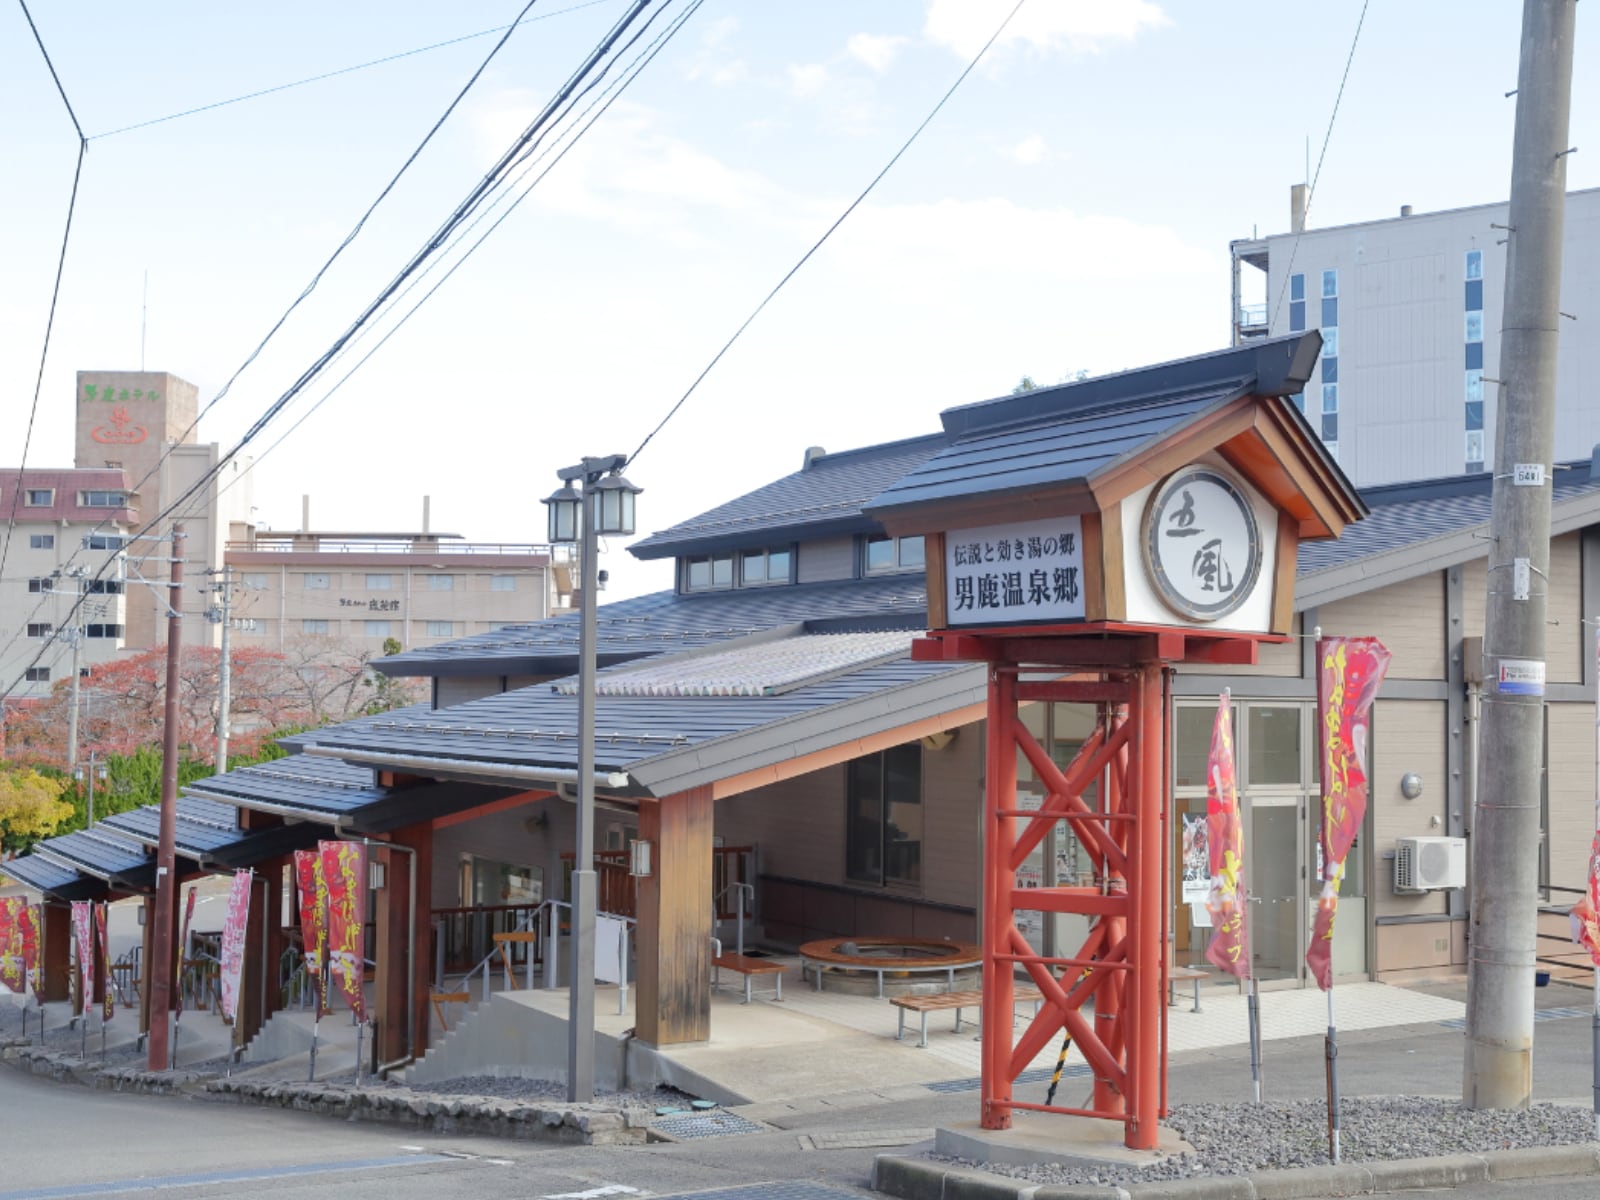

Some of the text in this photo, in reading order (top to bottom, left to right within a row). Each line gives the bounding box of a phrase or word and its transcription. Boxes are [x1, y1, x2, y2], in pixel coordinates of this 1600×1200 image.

[954, 533, 1076, 567] 伝説と効き湯の郷
[954, 566, 1079, 612] 男鹿温泉郷
